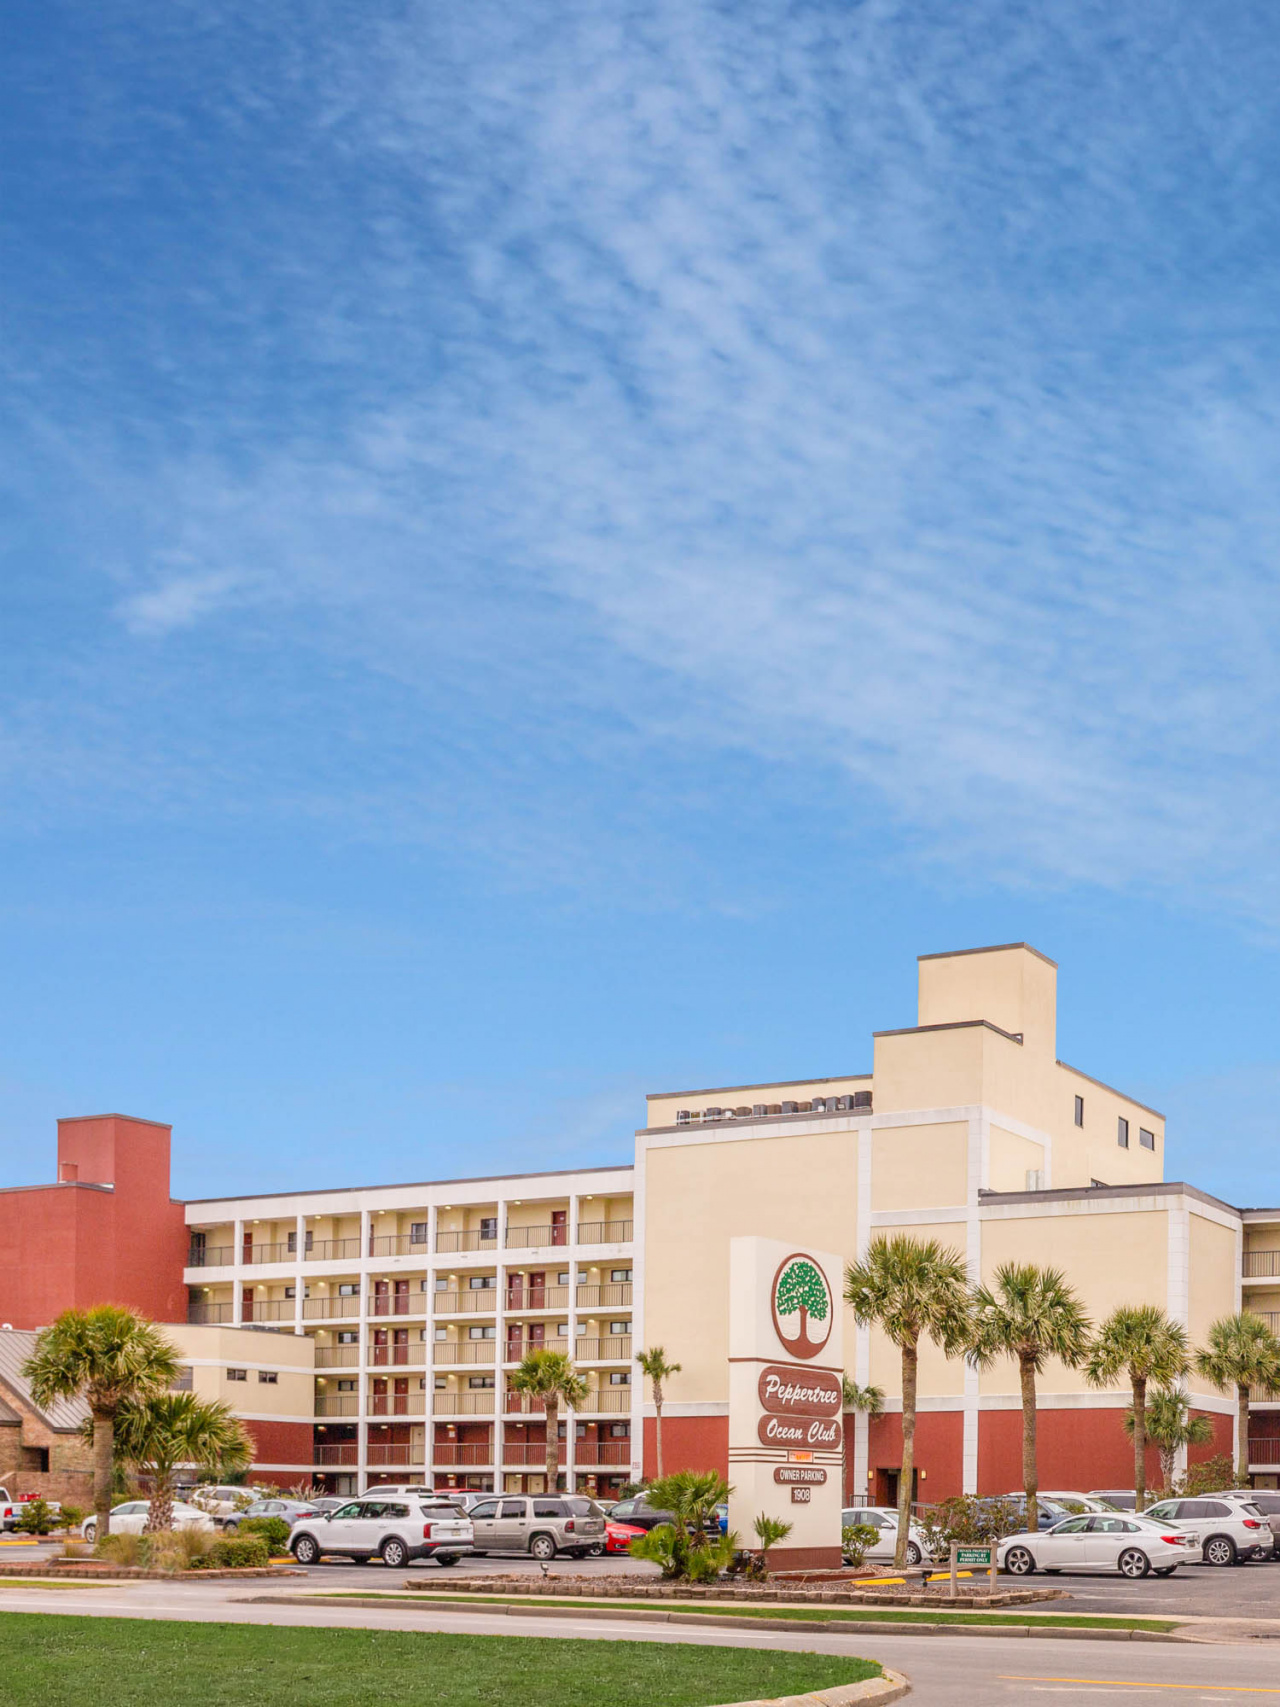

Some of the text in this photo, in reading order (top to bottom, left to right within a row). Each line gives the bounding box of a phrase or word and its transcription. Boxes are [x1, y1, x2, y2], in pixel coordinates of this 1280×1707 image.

[765, 1374, 838, 1406] Peppertree
[766, 1418, 837, 1443] Ocean Club
[780, 1470, 824, 1481] OWNER PARKING
[794, 1489, 810, 1501] 1908
